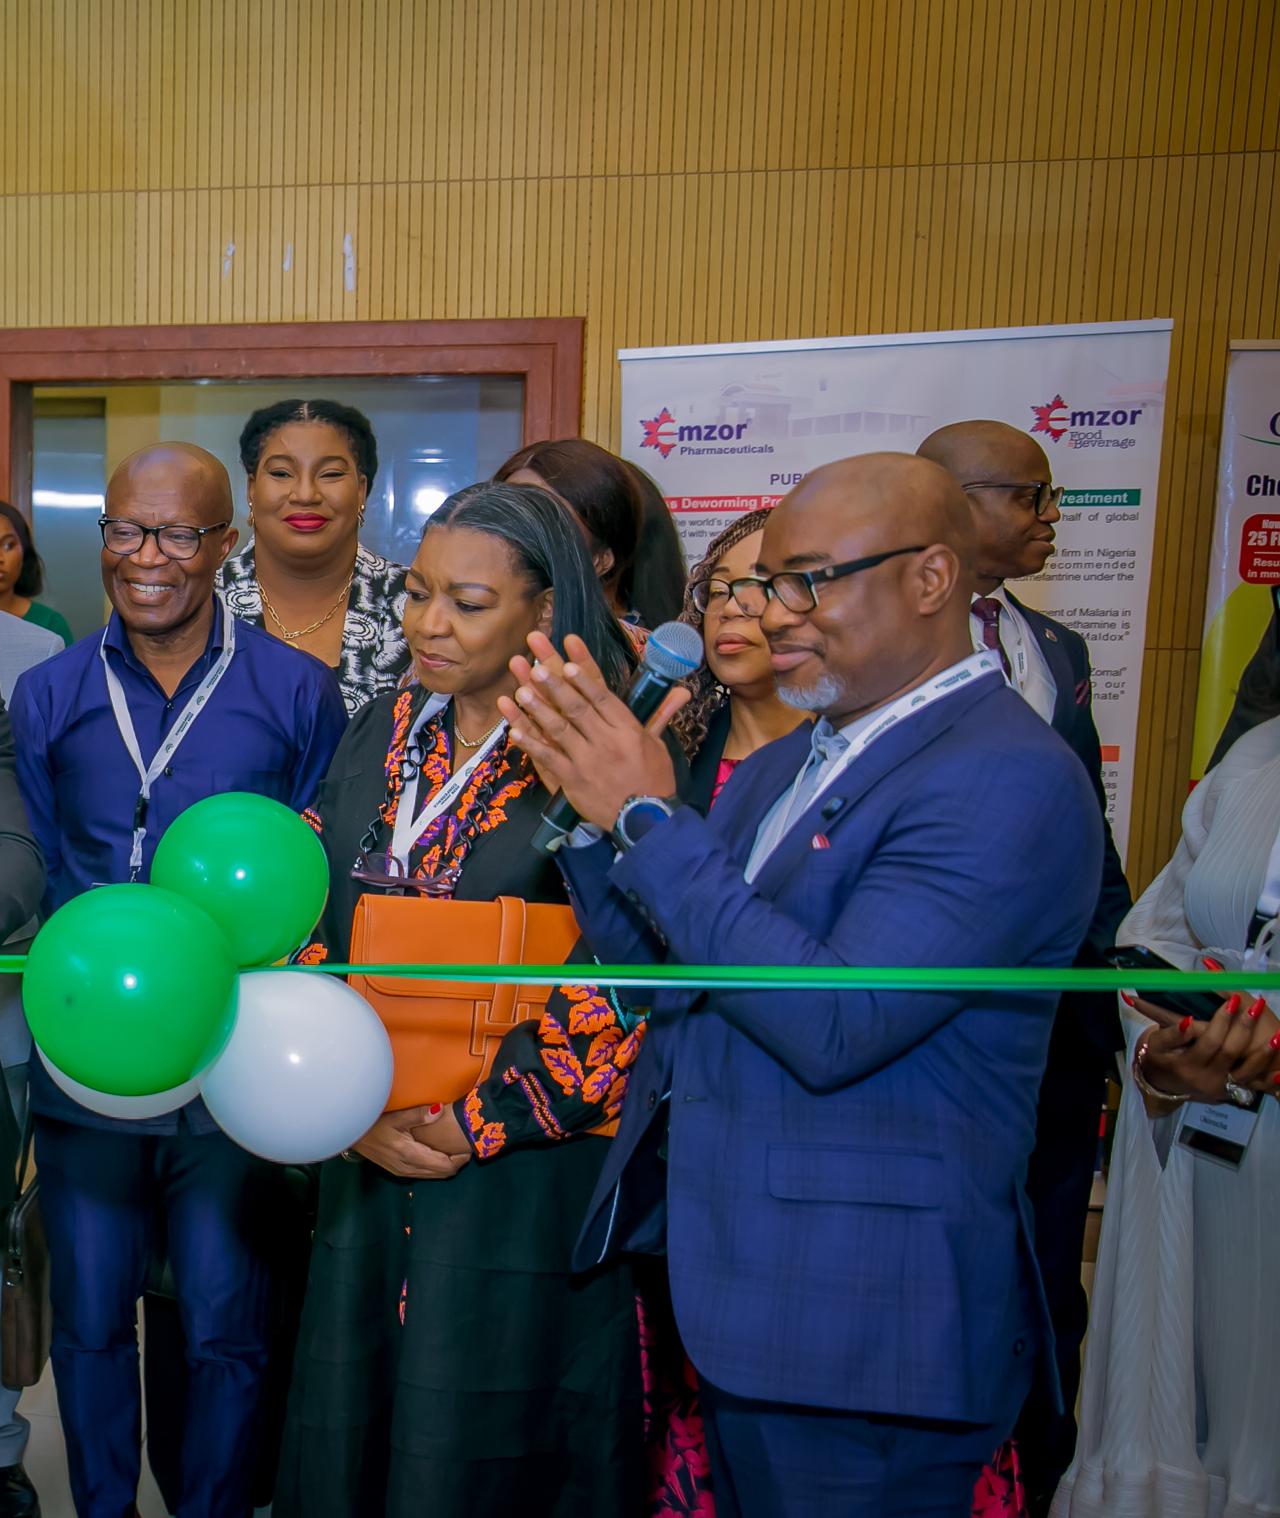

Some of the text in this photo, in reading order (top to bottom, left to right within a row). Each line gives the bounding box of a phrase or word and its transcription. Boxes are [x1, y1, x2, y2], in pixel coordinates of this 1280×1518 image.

[1069, 429, 1102, 440] Food
[1073, 437, 1136, 449] Beverage
[680, 444, 775, 456] Pharmaceuticals
[770, 473, 806, 486] PUB
[681, 496, 757, 510] Deworming
[1060, 492, 1129, 504] reatment
[1088, 511, 1100, 521] of
[1105, 512, 1140, 523] global
[1247, 531, 1267, 547] 25
[1061, 548, 1081, 557] firm
[1084, 548, 1094, 557] in
[1097, 547, 1136, 559] Nigeria
[1045, 560, 1136, 569] recommended
[1253, 557, 1280, 568] Resu
[1083, 572, 1115, 581] under
[1117, 572, 1134, 581] the
[1066, 608, 1078, 617] of
[1079, 608, 1119, 617] Malaria
[1122, 608, 1131, 617] in
[1121, 621, 1131, 629] is
[1104, 681, 1126, 689] our
